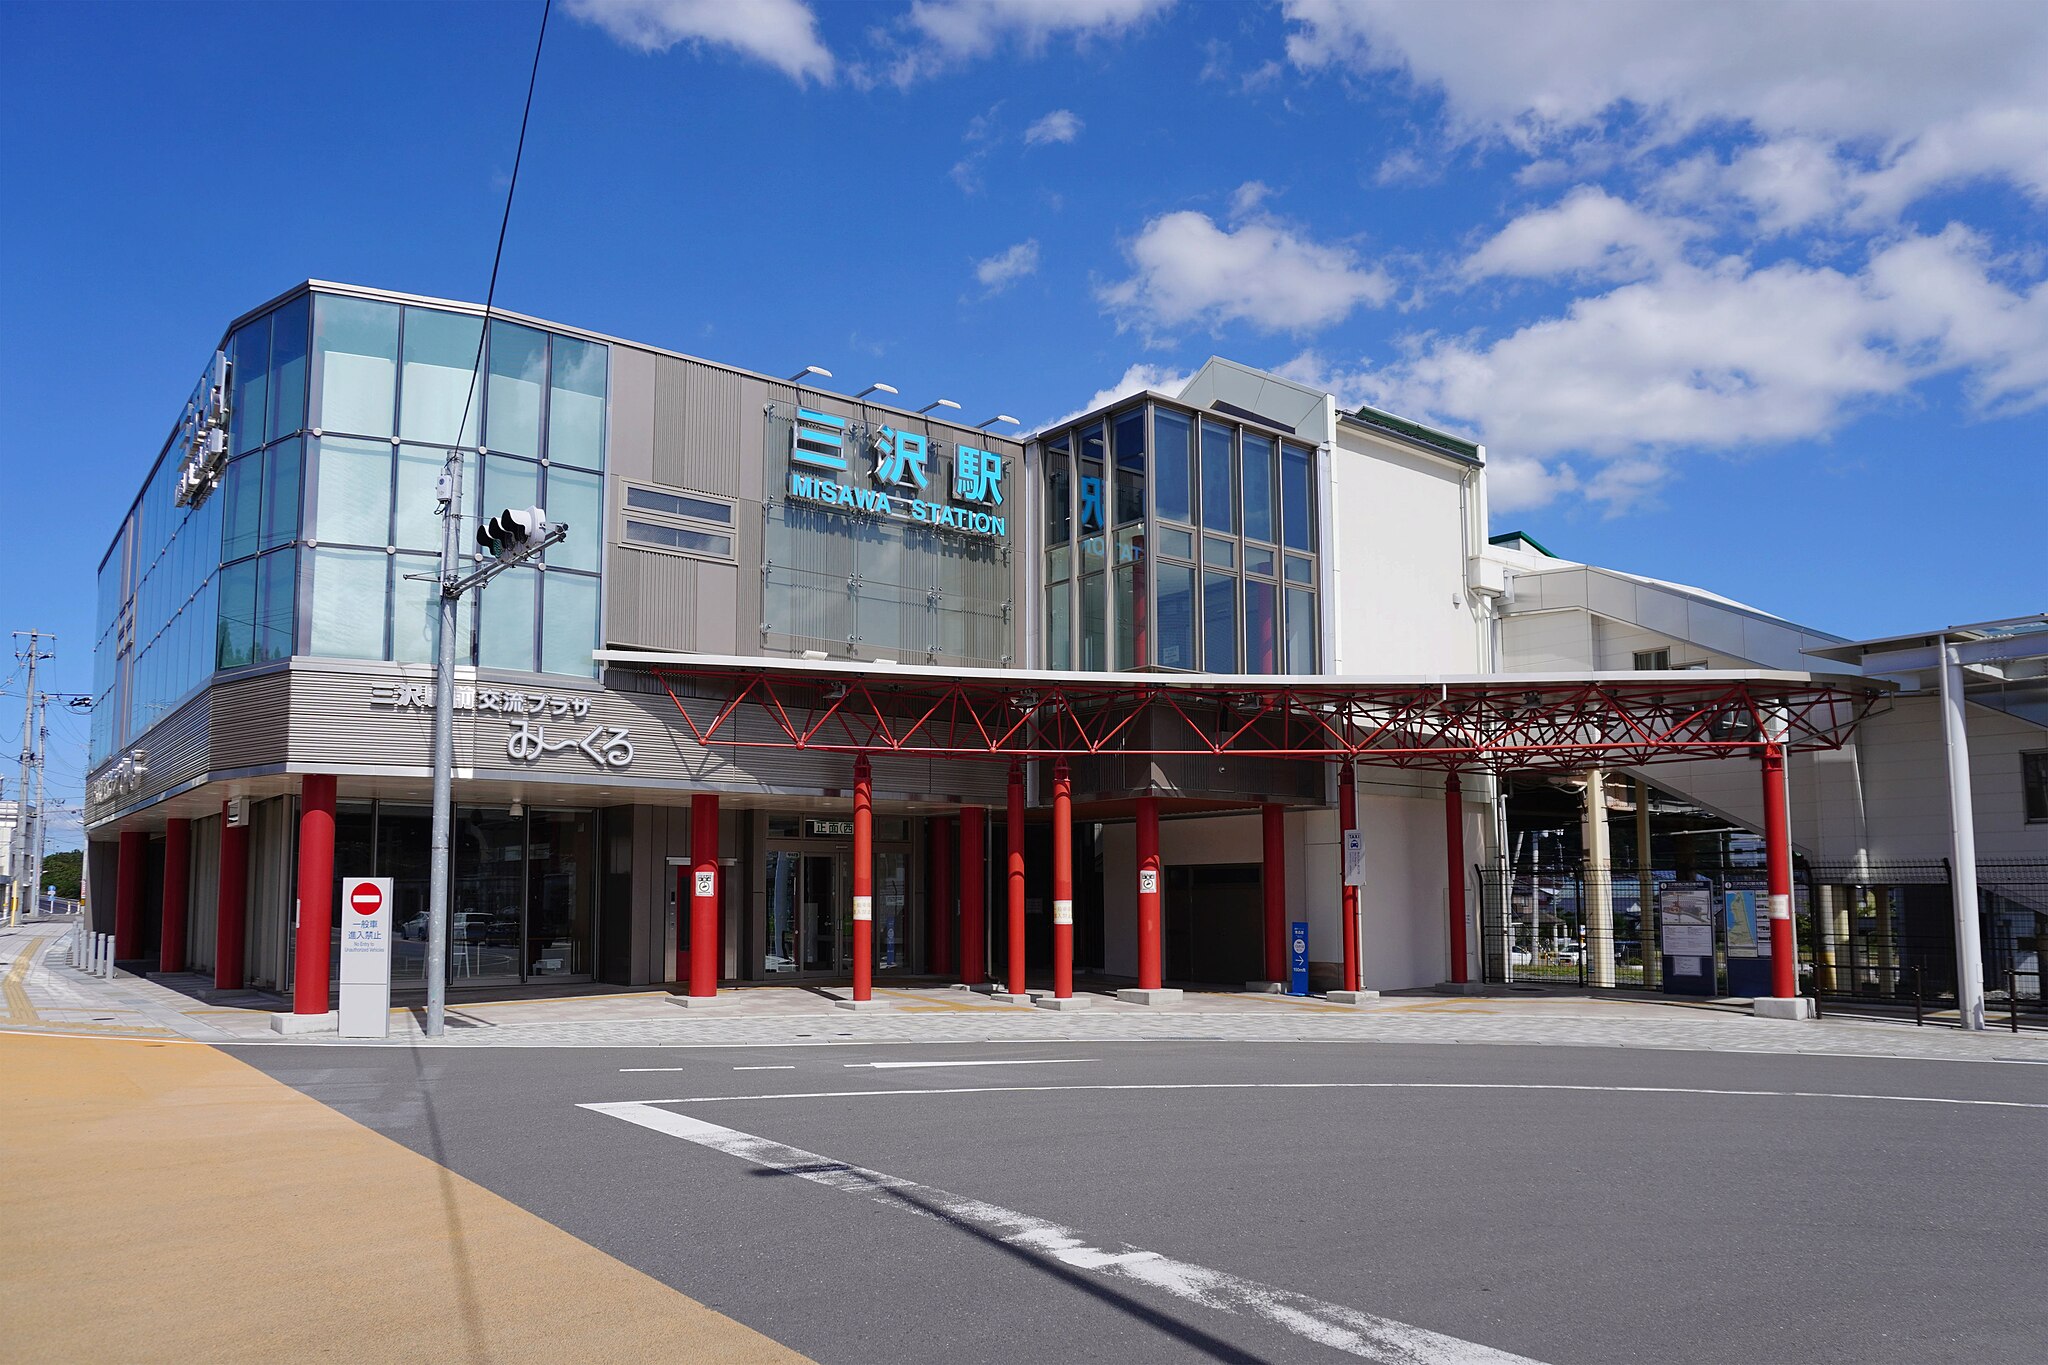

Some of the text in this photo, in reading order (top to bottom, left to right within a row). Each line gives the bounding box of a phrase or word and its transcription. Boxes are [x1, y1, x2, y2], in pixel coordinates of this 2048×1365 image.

[792, 407, 1003, 506] 三沢駅
[792, 474, 1005, 537] MISAWA STATION
[348, 931, 382, 940] 進入禁止
[352, 920, 378, 928] 一般車
